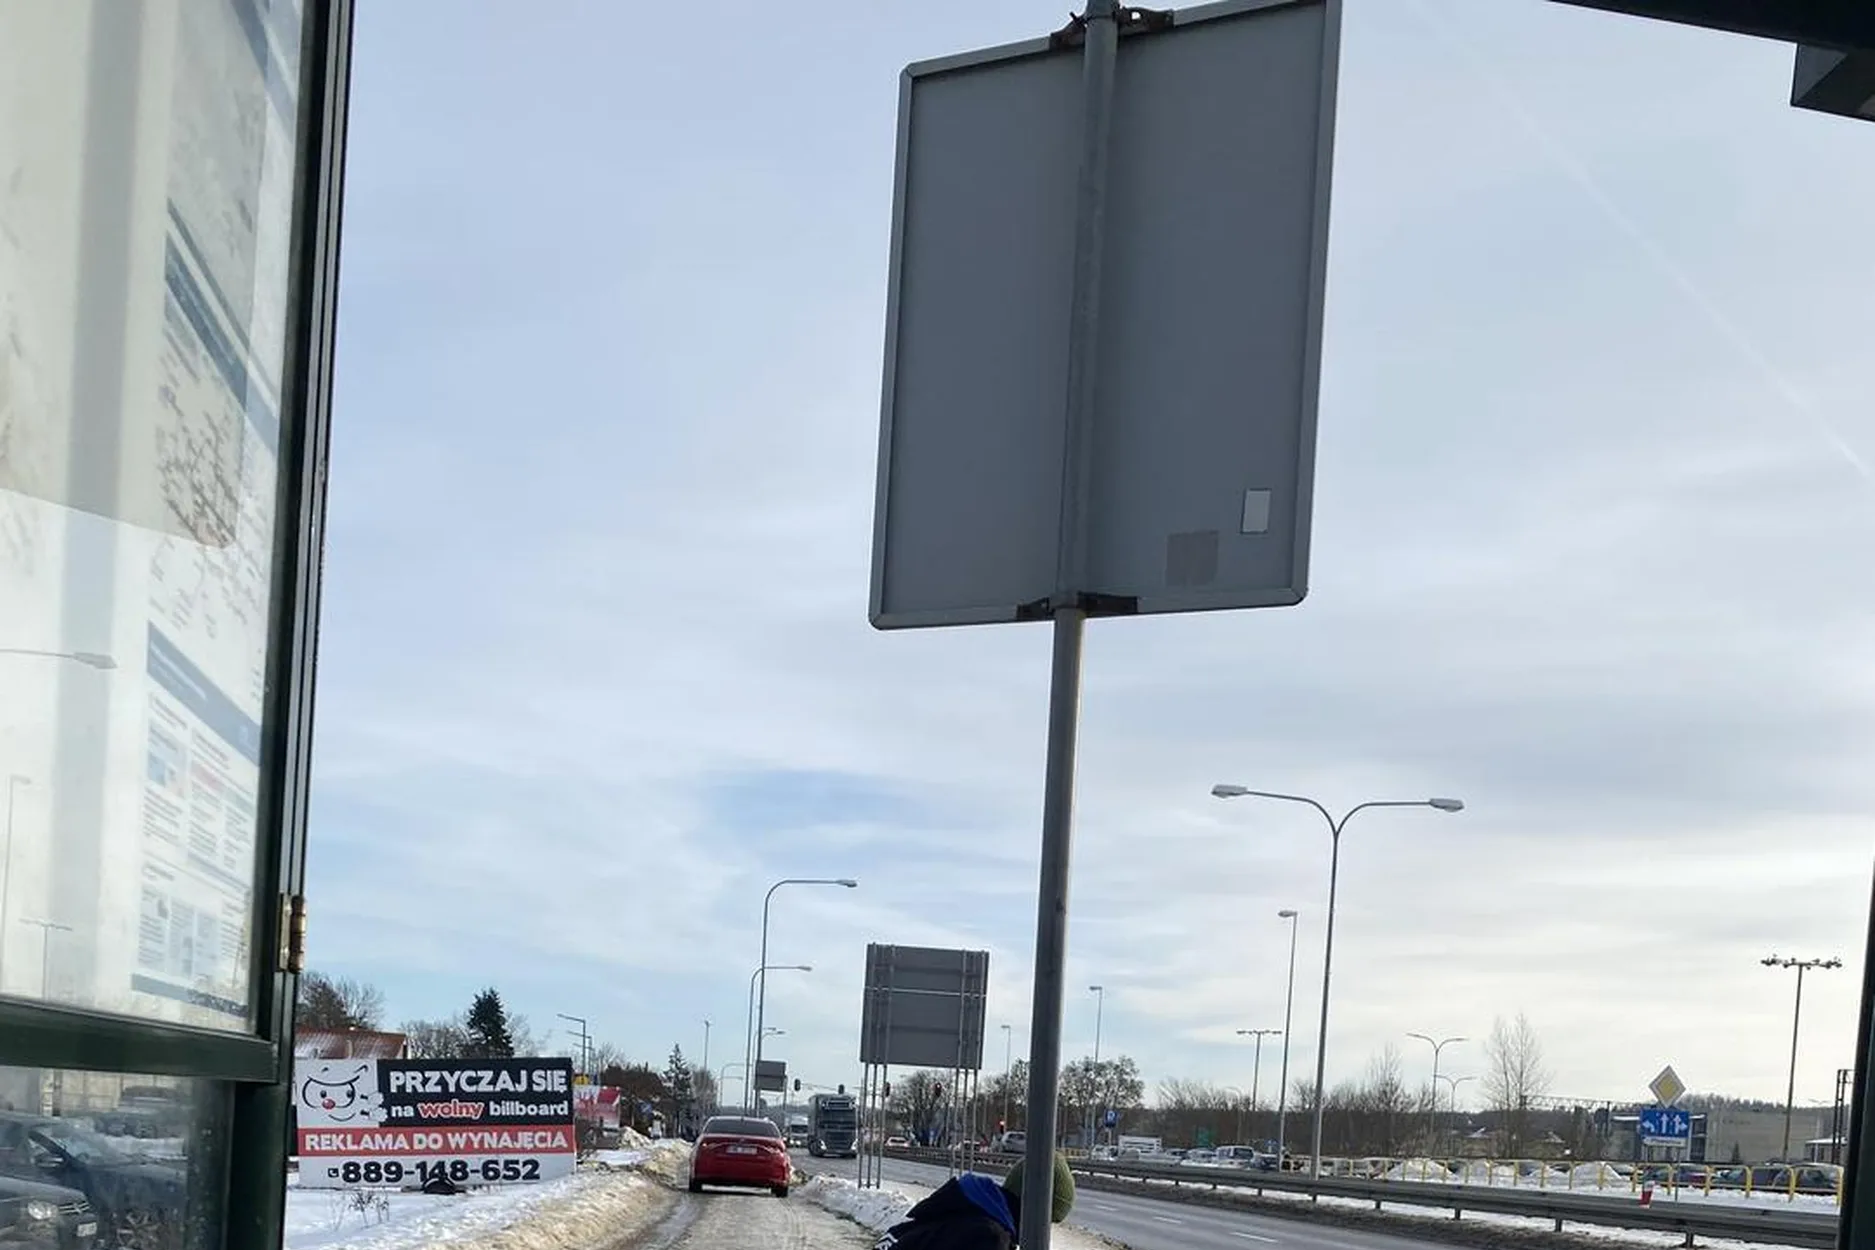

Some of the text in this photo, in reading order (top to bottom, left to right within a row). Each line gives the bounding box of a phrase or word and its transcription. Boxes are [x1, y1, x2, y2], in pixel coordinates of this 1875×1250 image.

[389, 1070, 567, 1093] PRZYCZAJ SIĘ
[391, 1100, 569, 1119] na wolny billboard
[305, 1131, 568, 1150] REKLAMA DO WYNAJĘCIA
[342, 1160, 540, 1183] 889-148-652
